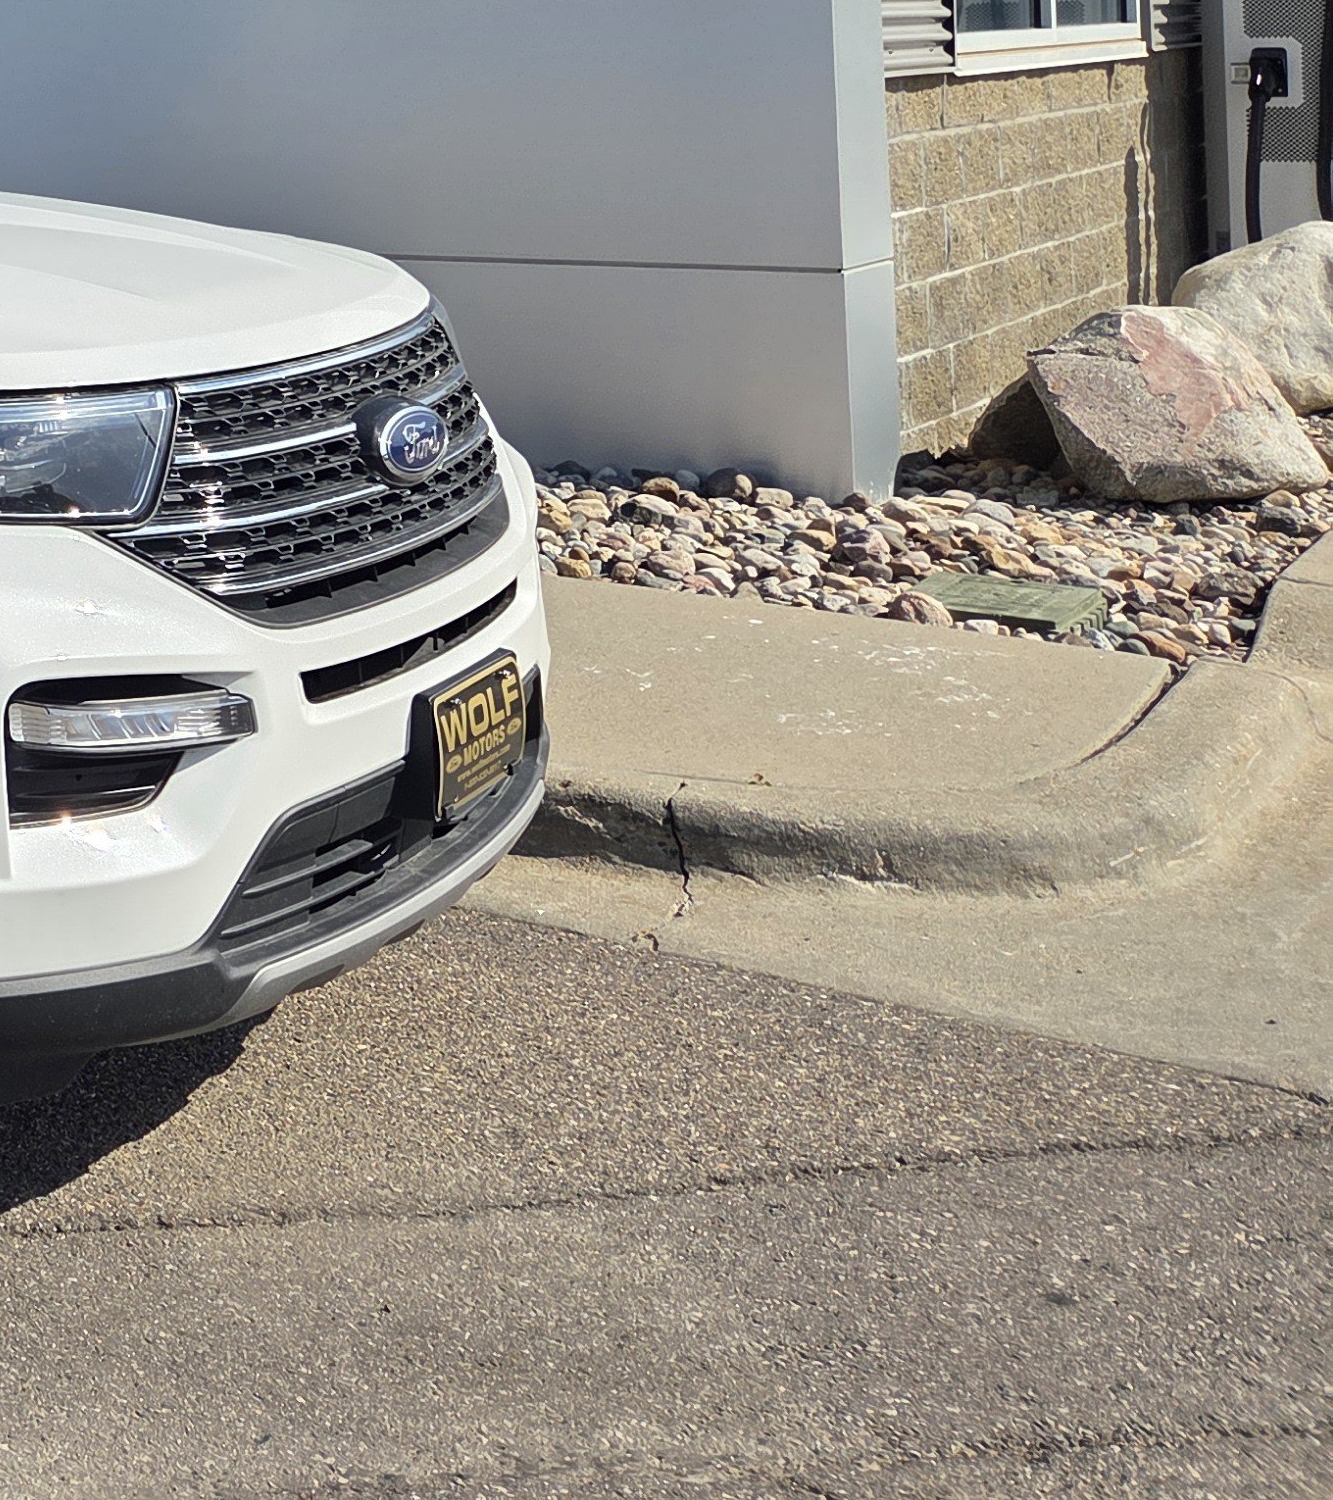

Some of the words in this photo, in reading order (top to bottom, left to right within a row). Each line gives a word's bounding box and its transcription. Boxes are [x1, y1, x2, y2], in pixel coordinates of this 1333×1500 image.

[402, 421, 440, 464] Ford
[440, 673, 520, 753] WOLF
[463, 724, 506, 767] MOTORS
